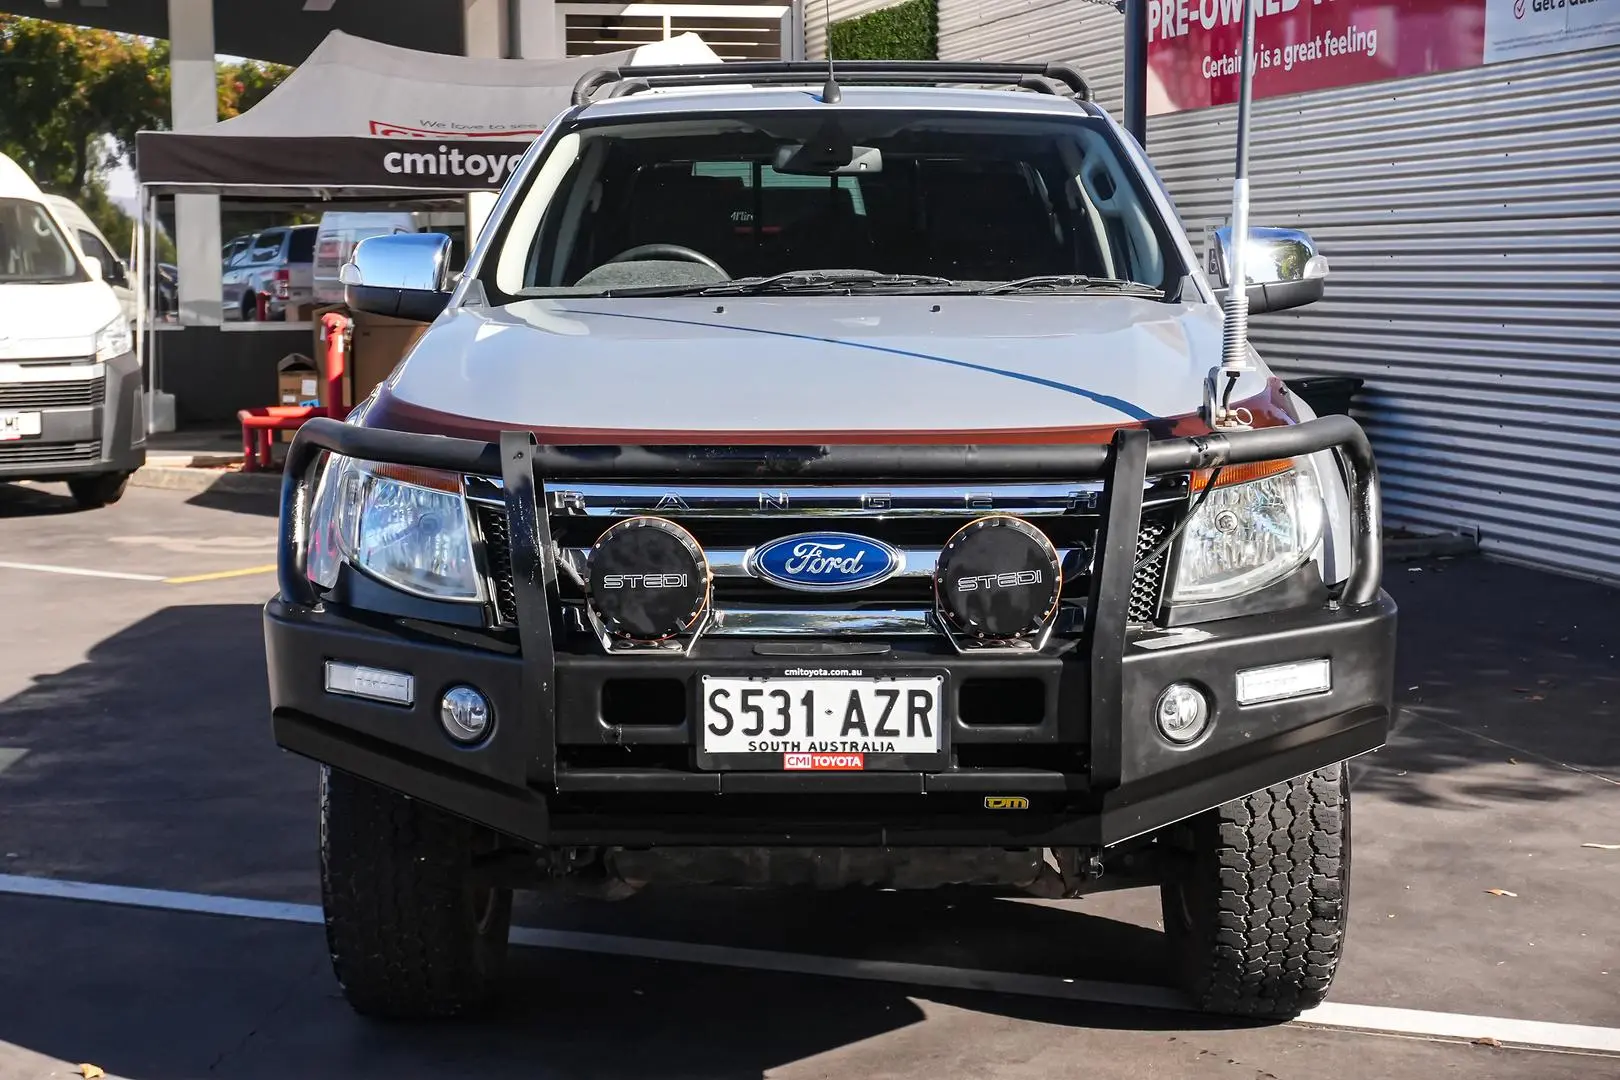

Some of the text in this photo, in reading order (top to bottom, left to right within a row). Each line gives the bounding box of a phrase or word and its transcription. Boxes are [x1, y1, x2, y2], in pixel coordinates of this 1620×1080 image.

[1260, 43, 1271, 69] is
[1273, 48, 1281, 67] a
[1284, 35, 1322, 72] great
[1324, 25, 1377, 57] feeling
[420, 119, 446, 129] We
[451, 122, 484, 130] love
[554, 490, 1097, 511] RANGER
[784, 541, 865, 576] Ford
[603, 573, 688, 590] STEDI
[957, 569, 1043, 592] STEDI
[784, 667, 863, 678] cmitoyota.com.au
[708, 688, 934, 738] S531 AZR
[748, 741, 895, 752] SOUTH AUSTRALIA
[787, 756, 862, 767] CMI TOYOTA
